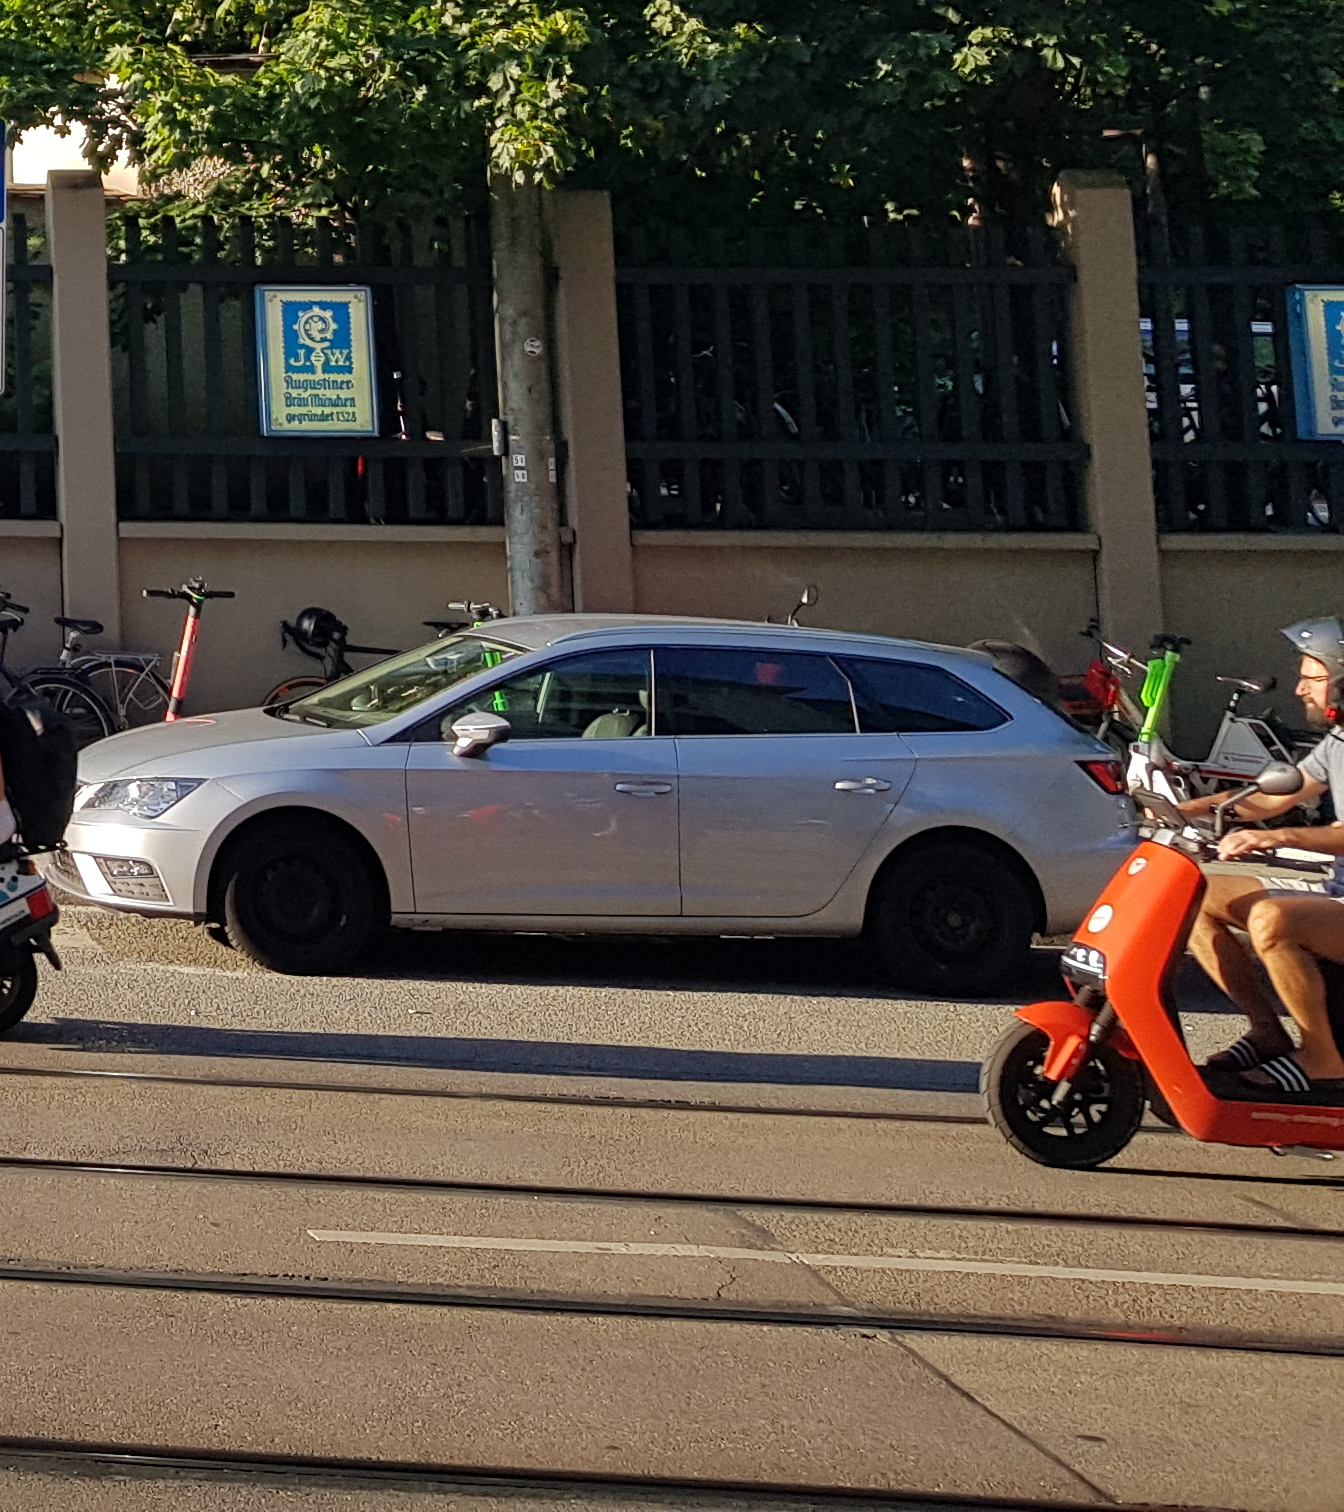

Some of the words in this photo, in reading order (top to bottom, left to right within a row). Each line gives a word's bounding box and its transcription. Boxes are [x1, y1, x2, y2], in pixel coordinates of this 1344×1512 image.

[289, 349, 311, 366] J.
[323, 349, 350, 366] W.
[284, 392, 309, 408] Bräu
[308, 393, 356, 408] München
[285, 410, 334, 424] gegründet
